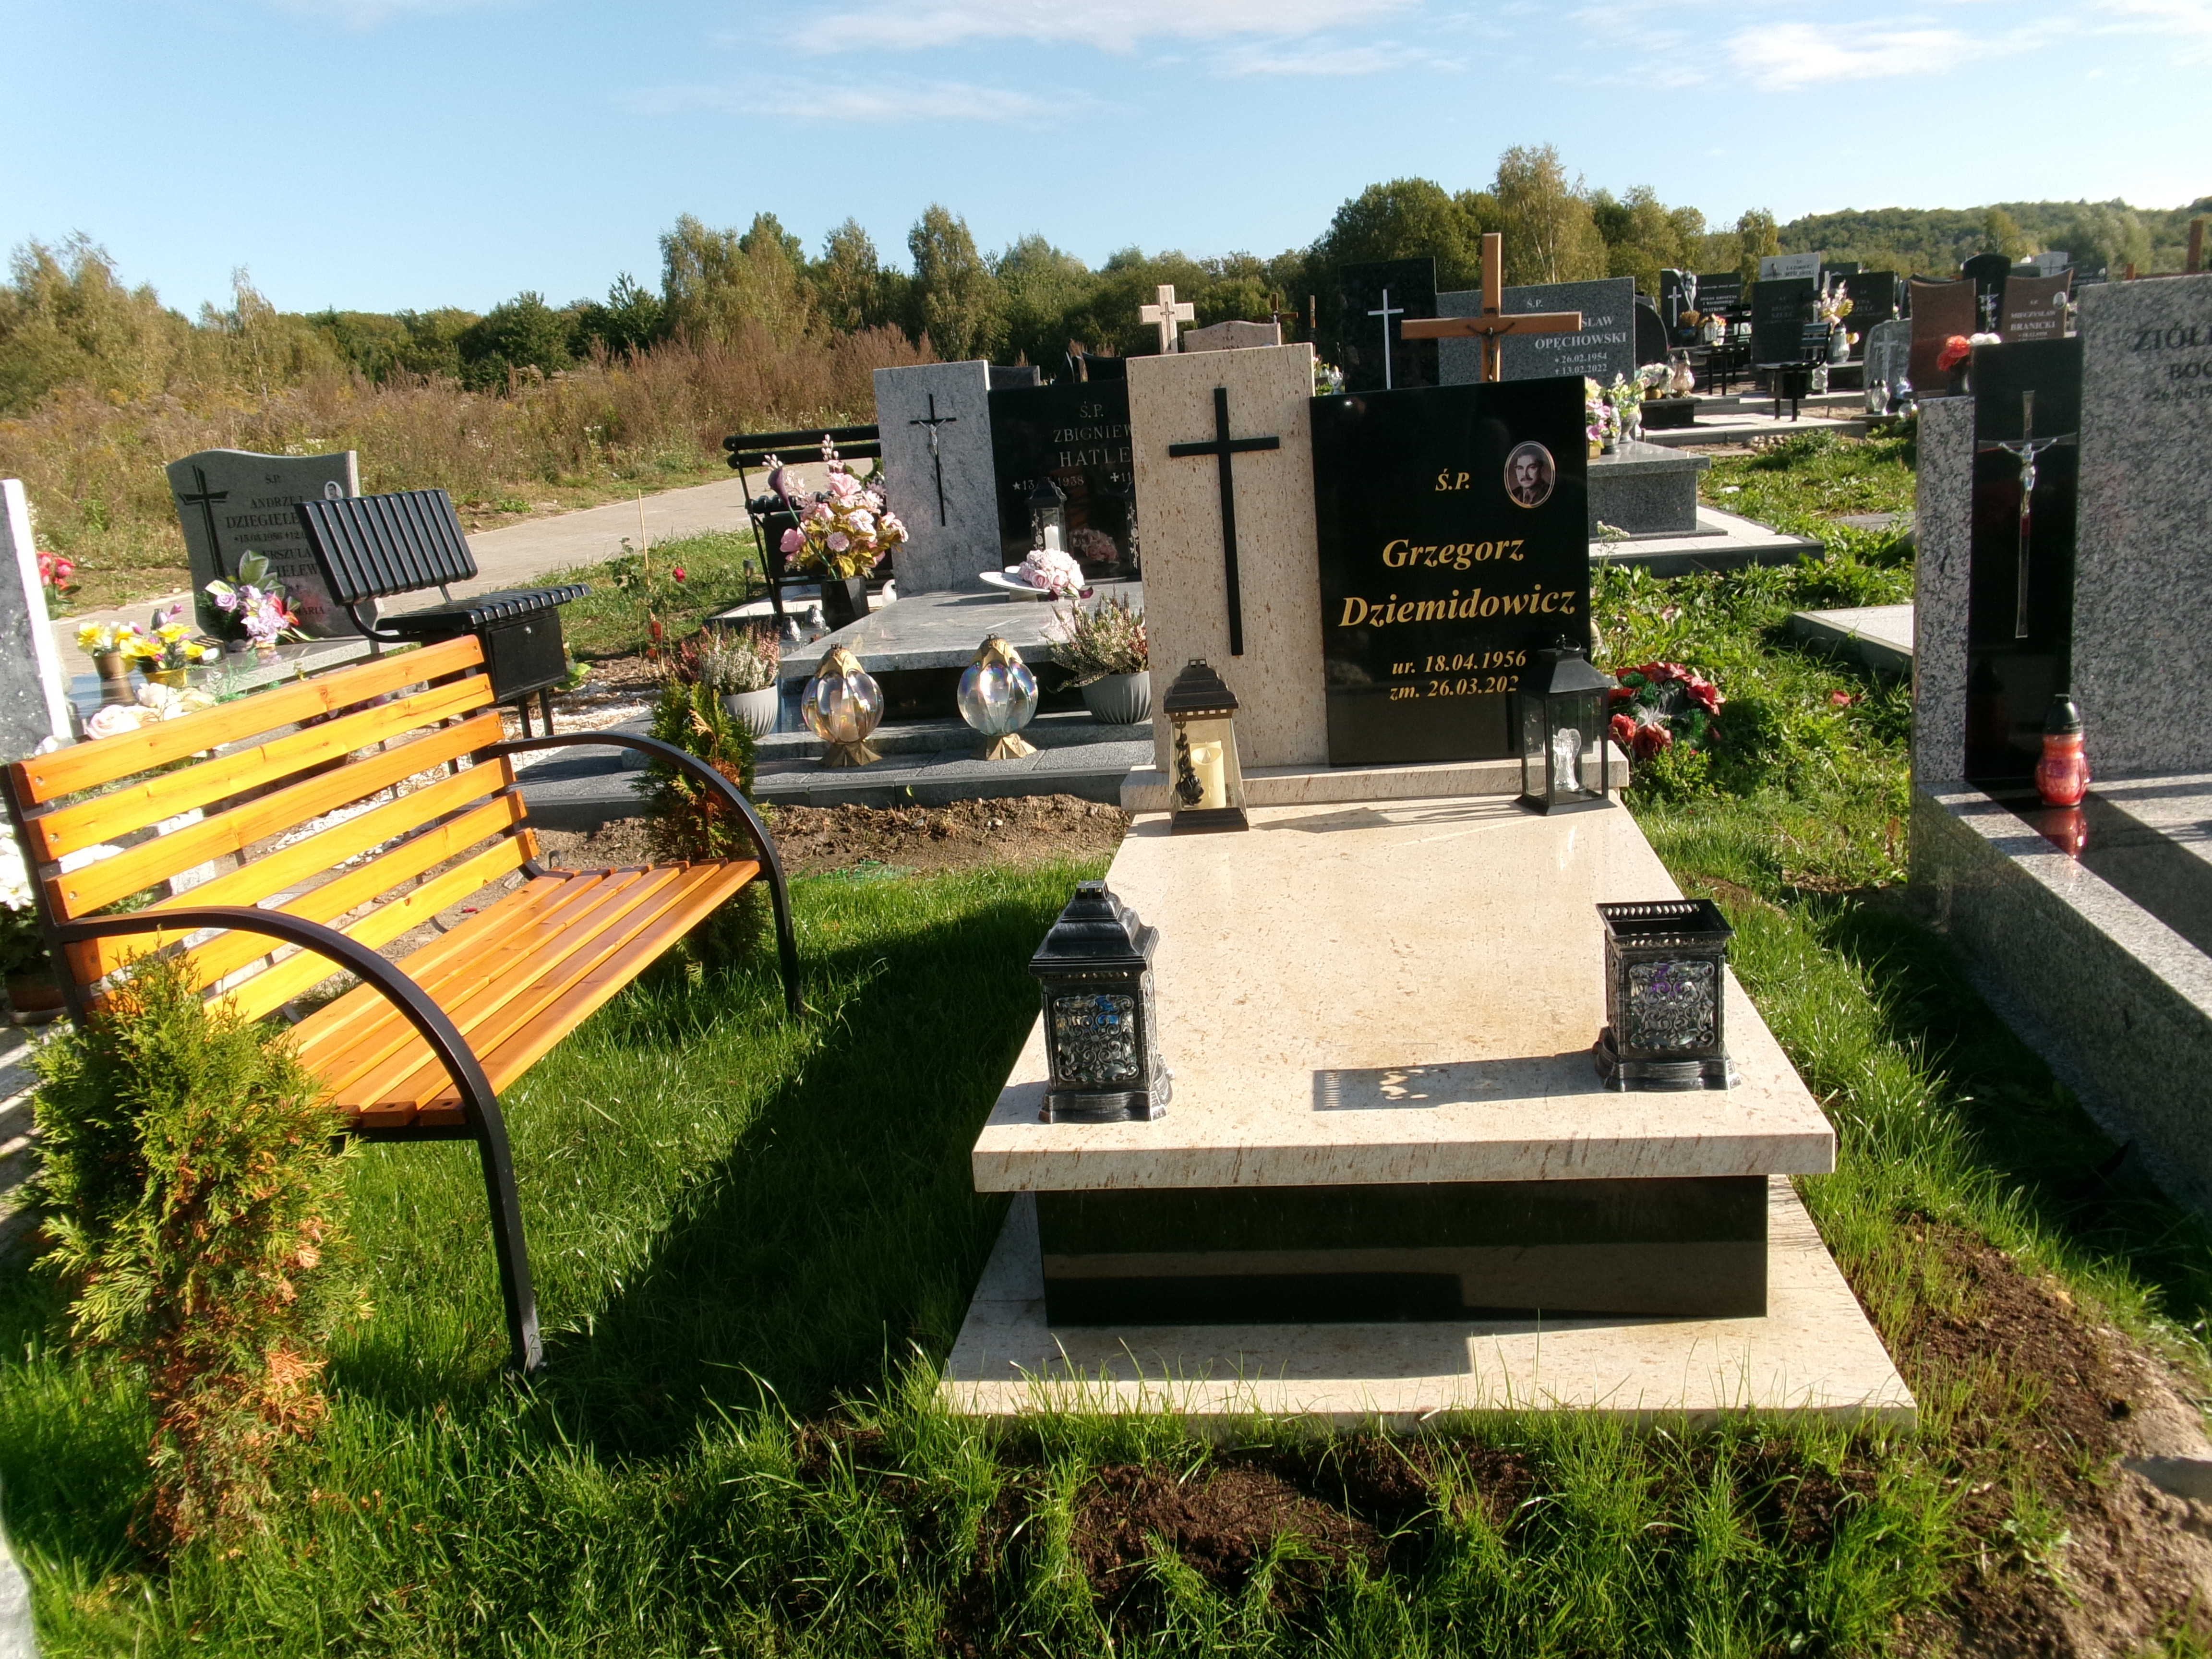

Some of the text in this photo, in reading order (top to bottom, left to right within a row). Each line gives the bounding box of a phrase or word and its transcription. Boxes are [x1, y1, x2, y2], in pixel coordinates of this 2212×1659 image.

[1581, 316, 1614, 327] SŁAW
[2010, 321, 2056, 331] BRANICKI
[1535, 332, 1627, 350] OPĘCHOWSKI
[1561, 352, 1607, 364] 26.02.1954
[1562, 363, 1607, 374] 13.02.2022
[1080, 400, 1104, 418] Ś.P.
[1059, 446, 1131, 467] HATLE
[1435, 469, 1470, 492] Ś.P.
[226, 512, 300, 529] DZIĘGIELE
[1382, 539, 1525, 570] Grzegorz
[1338, 584, 1576, 627] Dziemidowicz
[1392, 649, 1527, 674] ur. 18.04.1956
[1389, 674, 1519, 700] zm. 26.03.202
